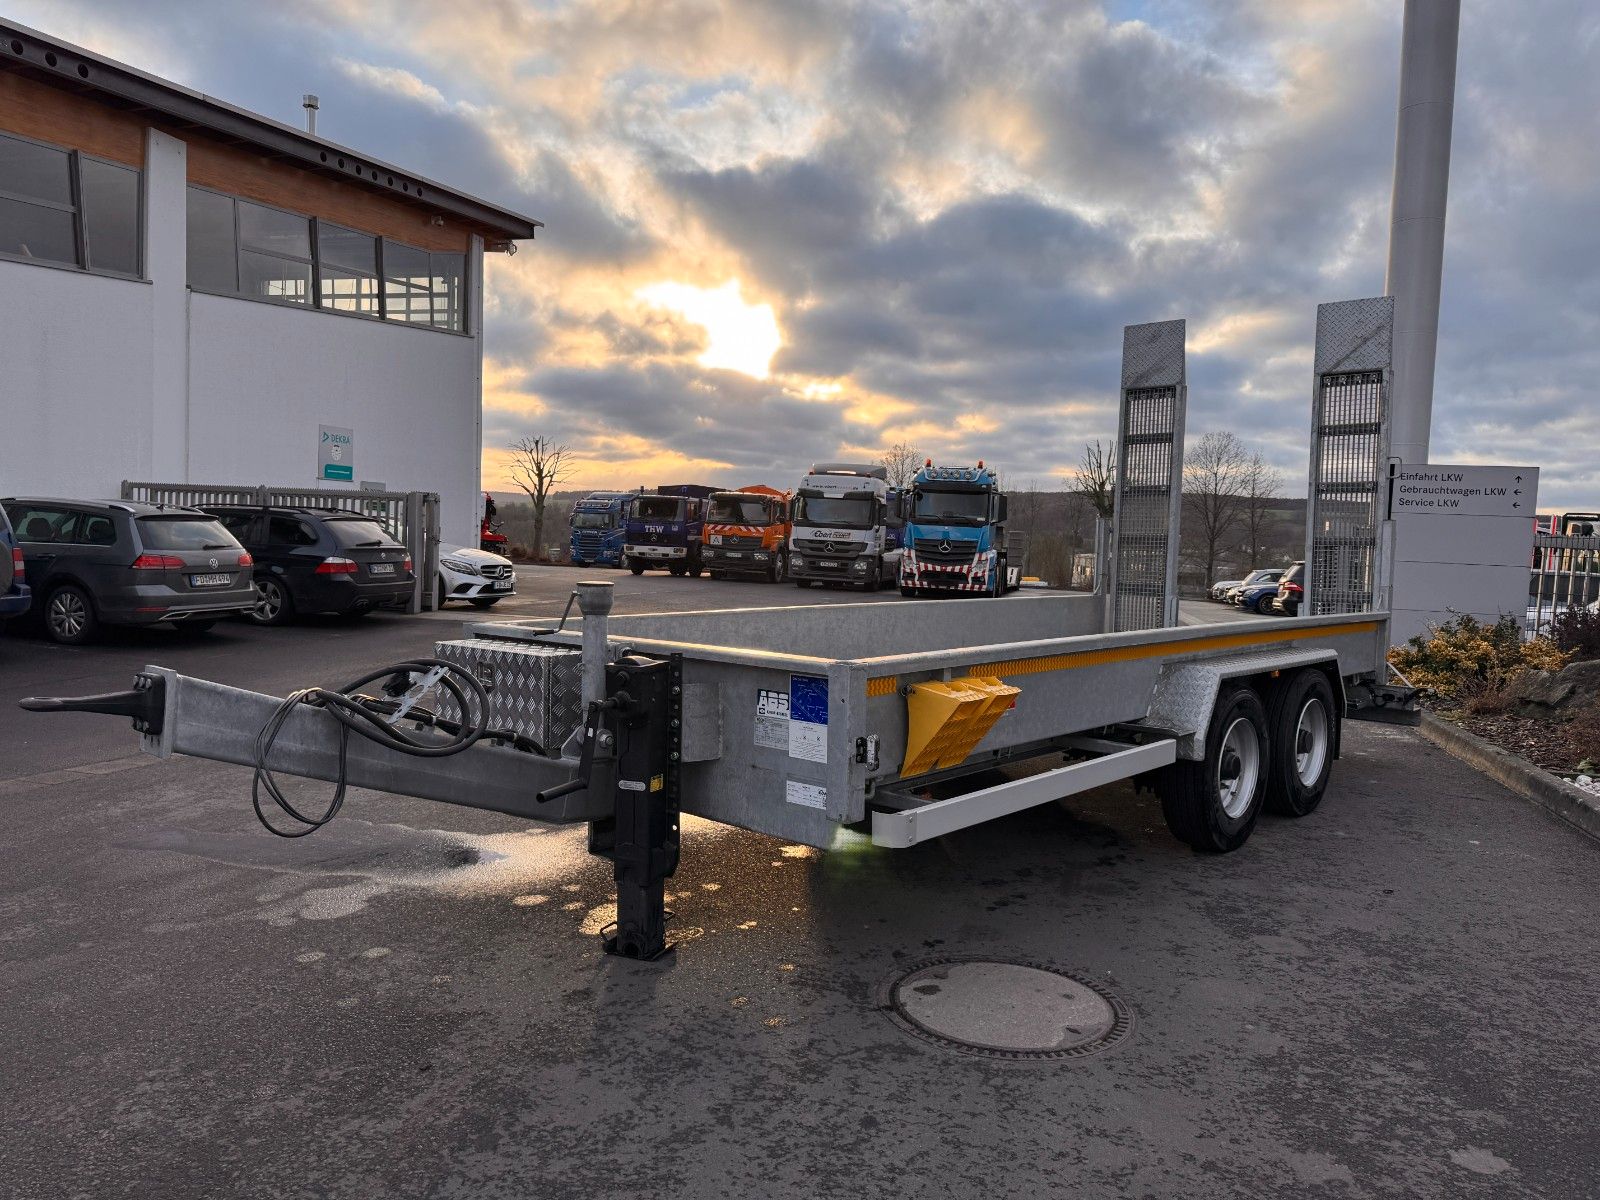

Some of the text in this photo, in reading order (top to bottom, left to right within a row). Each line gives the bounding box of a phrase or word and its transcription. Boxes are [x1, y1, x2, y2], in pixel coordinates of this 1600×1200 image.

[330, 433, 351, 445] DEKRA
[1400, 472, 1463, 482] Einfahrt LKW
[1399, 484, 1507, 497] Gebrauchtwagen LKW
[1398, 497, 1460, 508] Service LKW
[644, 525, 665, 534] THW
